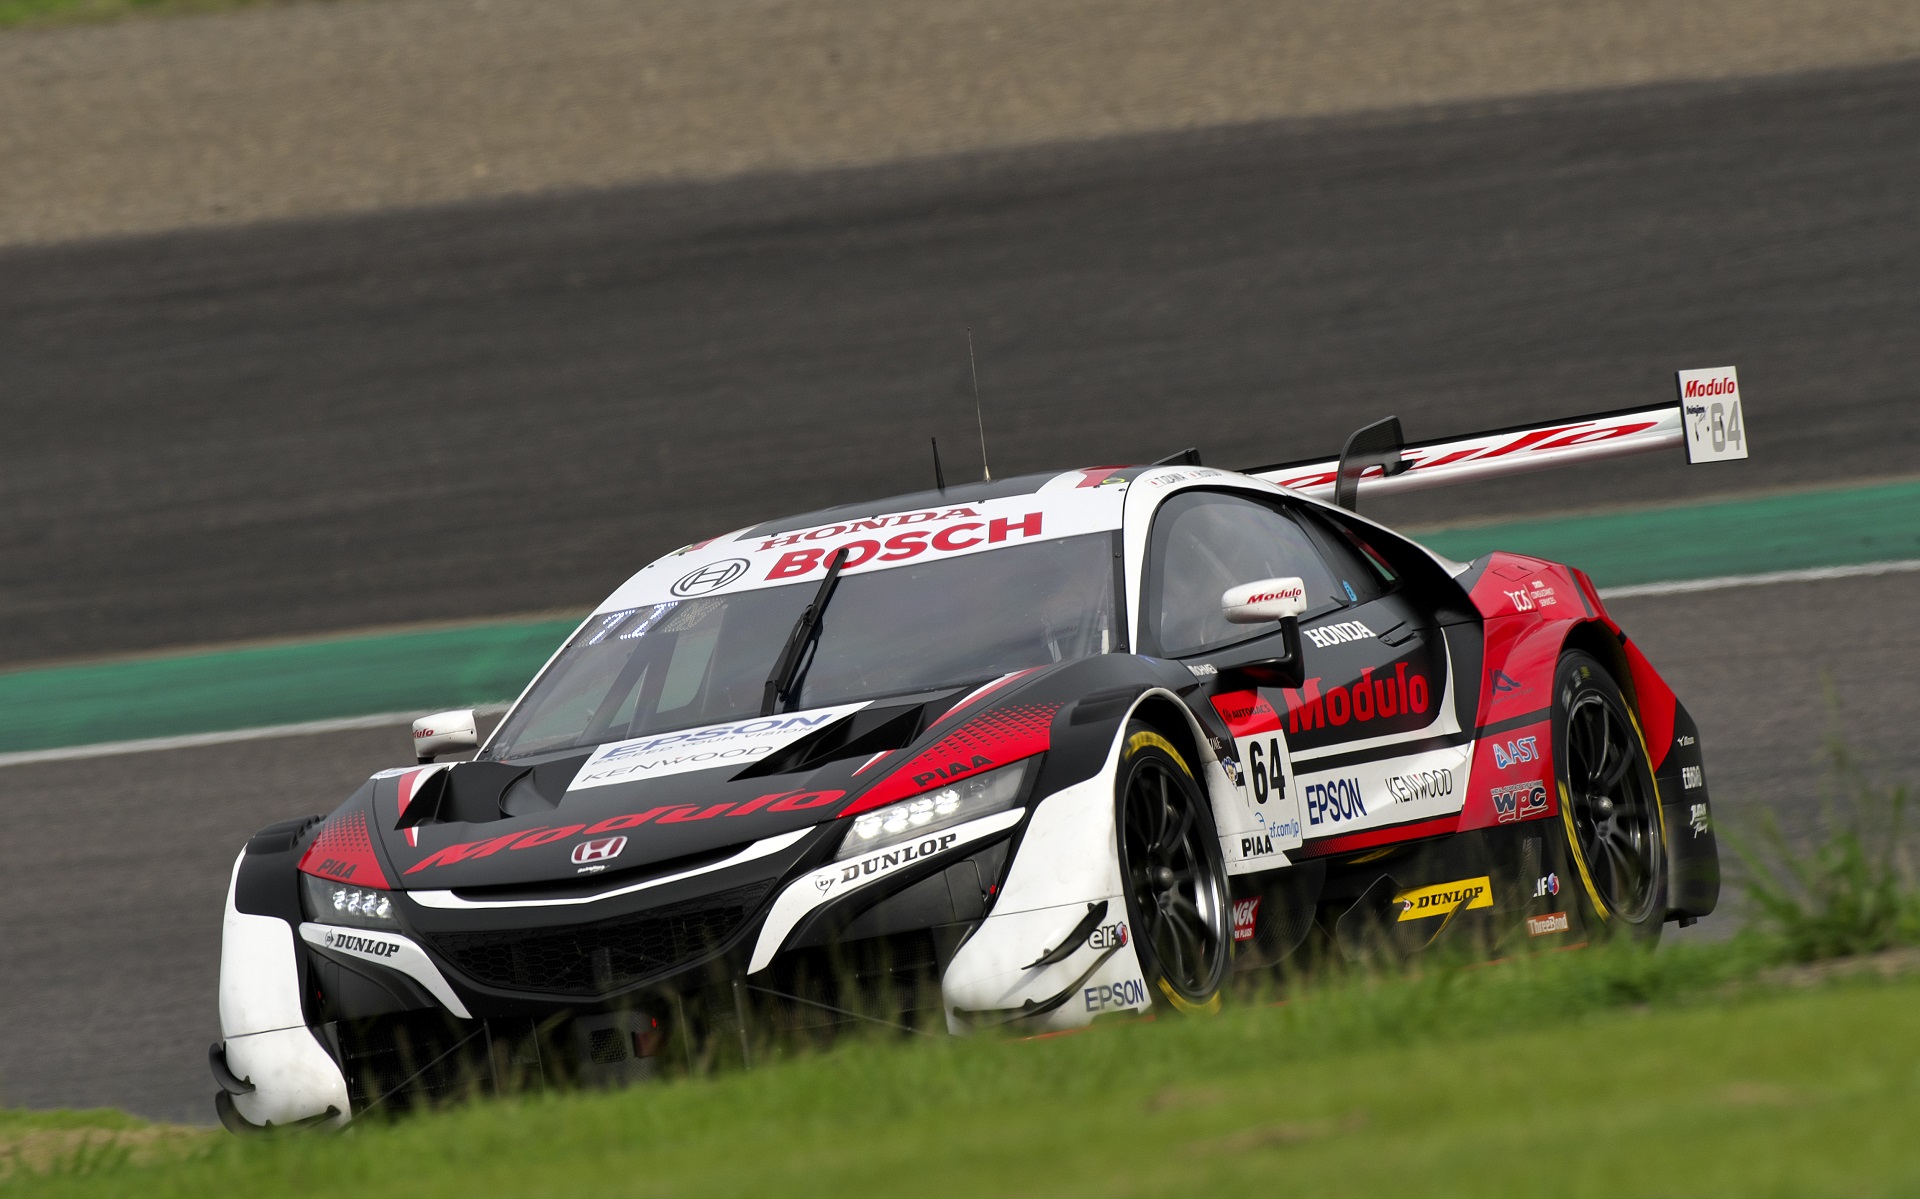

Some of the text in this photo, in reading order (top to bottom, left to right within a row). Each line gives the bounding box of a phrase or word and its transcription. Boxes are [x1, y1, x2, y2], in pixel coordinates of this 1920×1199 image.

[1685, 377, 1735, 398] Modulo
[1711, 401, 1741, 452] 64
[755, 507, 981, 552] HONDA
[764, 512, 1043, 581] BOSCH
[1247, 587, 1301, 605] Modulo
[1303, 621, 1377, 648] HONDA
[1232, 704, 1271, 719] AUTOBACS
[1283, 662, 1429, 734] Modulo
[602, 714, 833, 759] EPSON
[682, 736, 735, 748] YOUR
[745, 726, 814, 739] VISION
[582, 746, 773, 782] KENWOOD
[912, 754, 995, 787] PIAA
[1249, 738, 1286, 804] 64
[1305, 777, 1368, 825] EPSON
[1385, 768, 1453, 804] KENWOOD
[403, 788, 847, 875] Modulo
[1269, 818, 1300, 838] zf.com/jp
[841, 833, 957, 884] DUNLOP
[1241, 835, 1274, 857] PIAA
[316, 859, 358, 878] PIAA
[1417, 886, 1484, 909] DUNLOP
[1528, 914, 1568, 935] ThreeBond
[334, 934, 400, 958] DUNLOP
[1084, 979, 1144, 1012] EPSON
